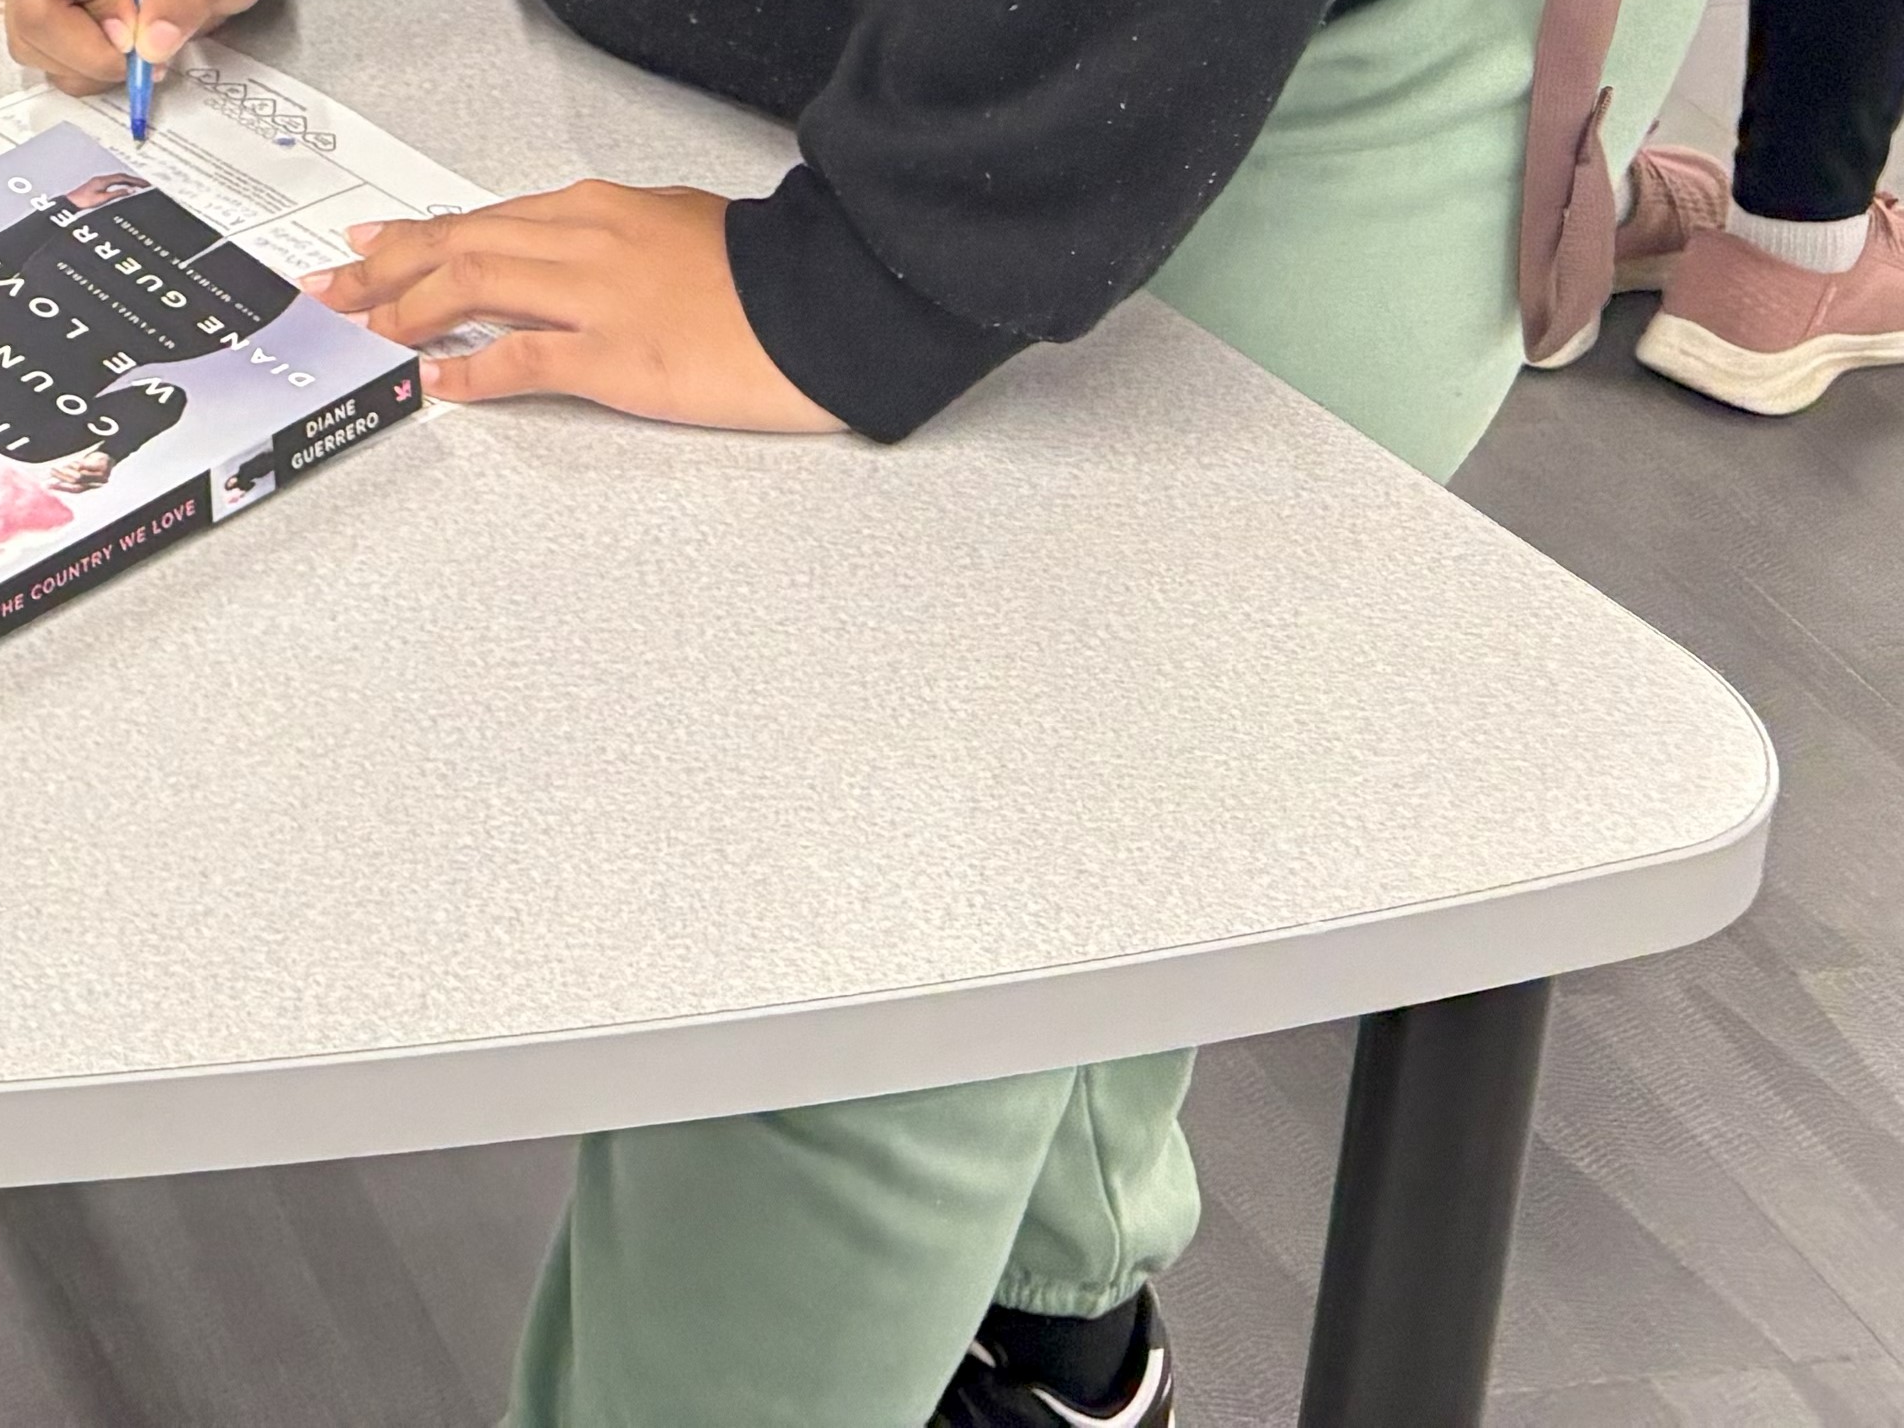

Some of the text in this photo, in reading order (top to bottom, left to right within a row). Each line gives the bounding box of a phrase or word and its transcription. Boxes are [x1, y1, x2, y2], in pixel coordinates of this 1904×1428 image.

[95, 348, 185, 405] WE
[190, 310, 319, 391] DIANE
[291, 412, 378, 468] GUERRERO
[306, 399, 355, 438] DIANE
[30, 544, 112, 599] COUNTRY
[119, 526, 145, 550] WE
[151, 499, 195, 534] LOVE
